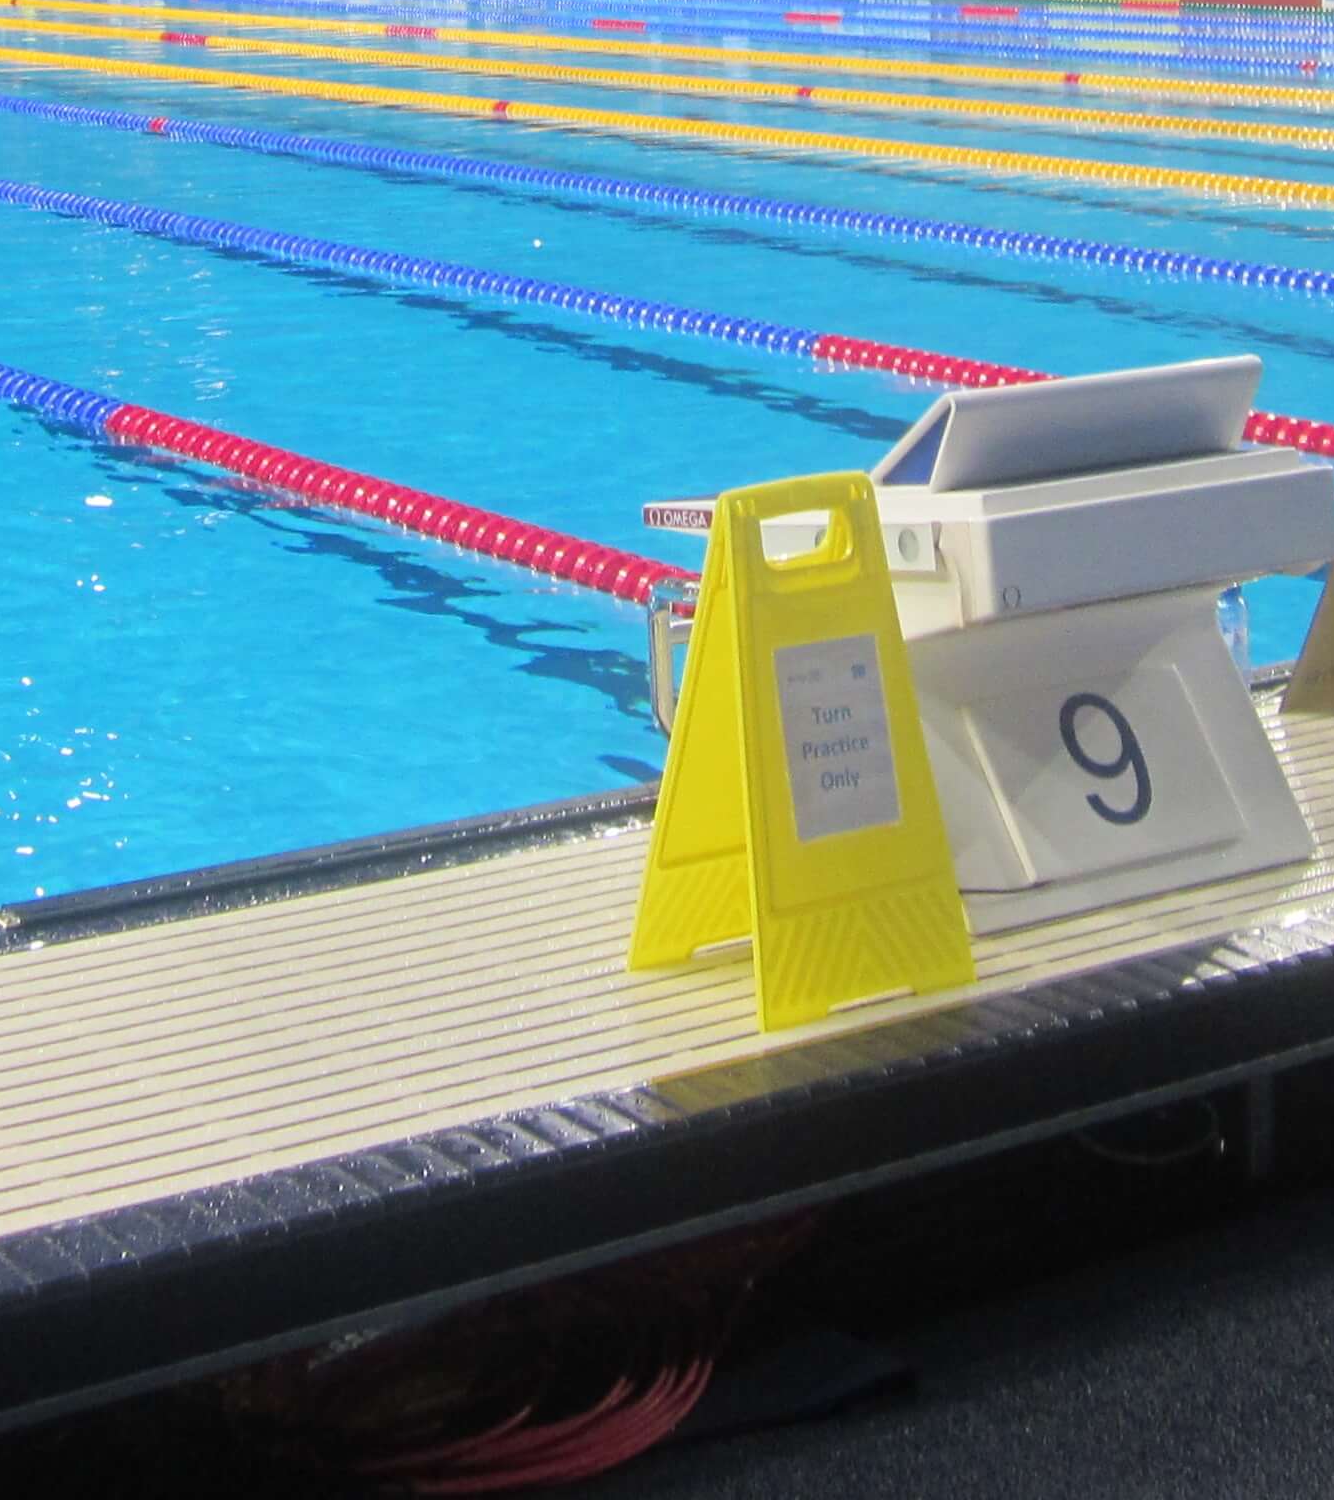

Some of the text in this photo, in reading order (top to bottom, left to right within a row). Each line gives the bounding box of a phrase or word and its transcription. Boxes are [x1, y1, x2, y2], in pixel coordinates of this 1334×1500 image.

[664, 510, 708, 527] OMEGA
[812, 706, 852, 725] Turn
[802, 736, 869, 761] Practice
[1059, 692, 1152, 826] 9
[821, 766, 860, 791] Only
